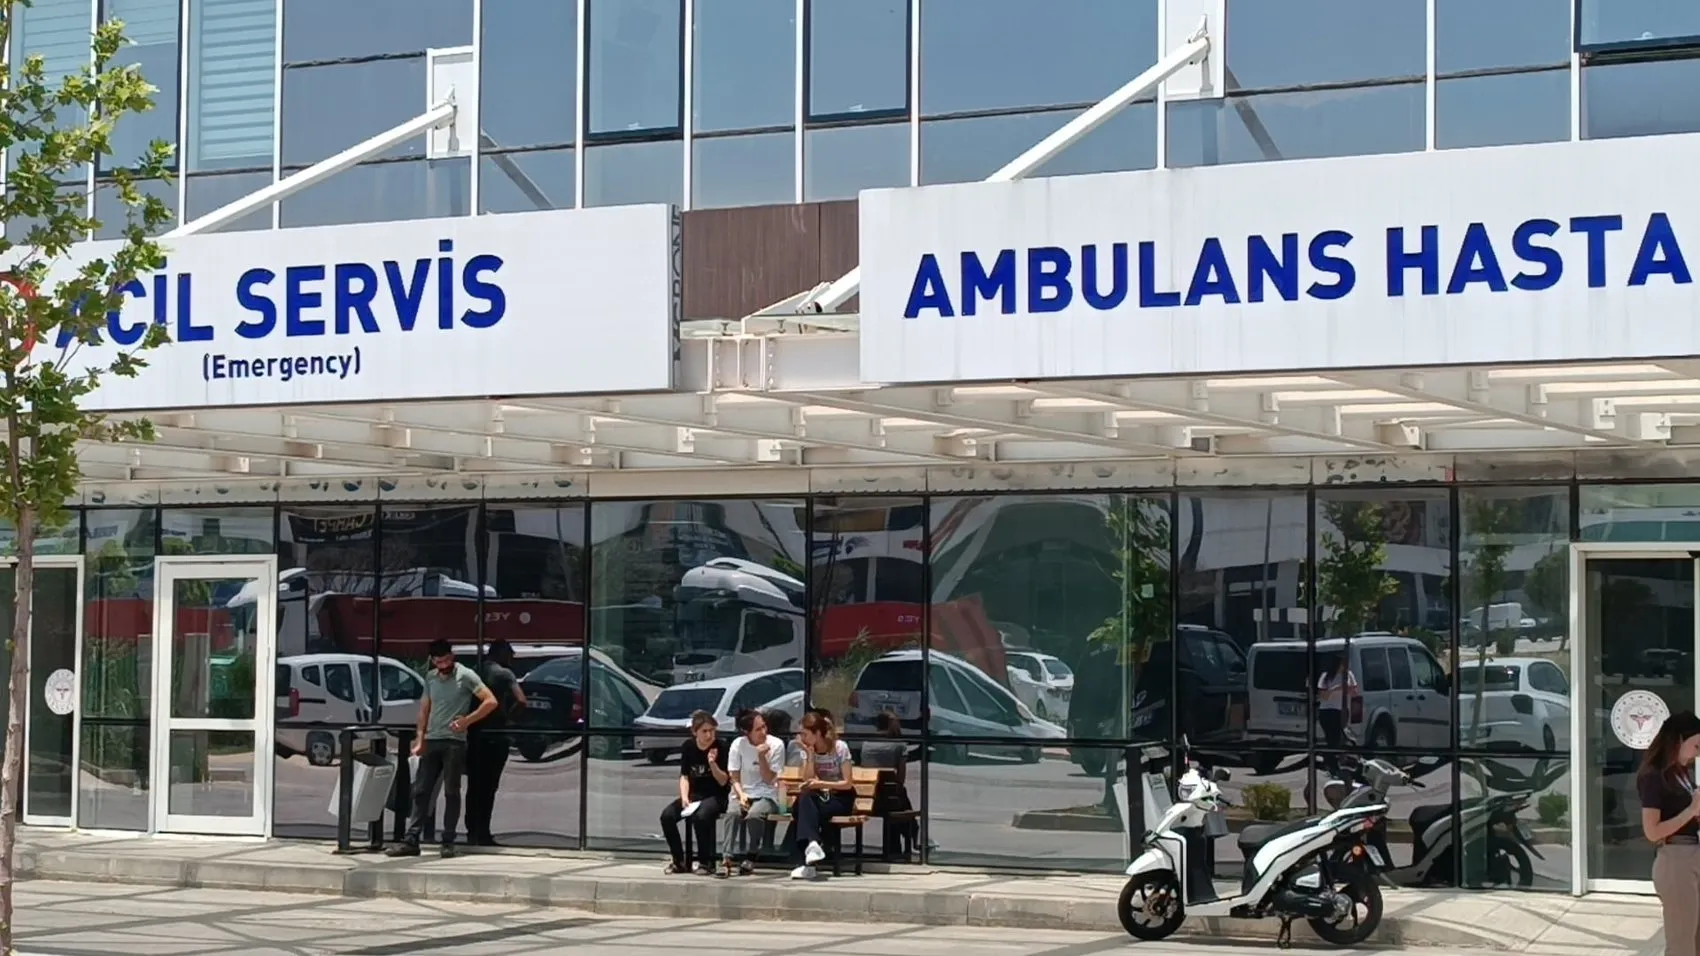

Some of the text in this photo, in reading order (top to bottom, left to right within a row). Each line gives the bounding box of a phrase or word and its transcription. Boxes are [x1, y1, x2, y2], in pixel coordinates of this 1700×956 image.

[235, 239, 507, 339] SERVİS
[904, 212, 1694, 319] AMBULANS HASTA
[203, 347, 361, 381] (Emergency)
